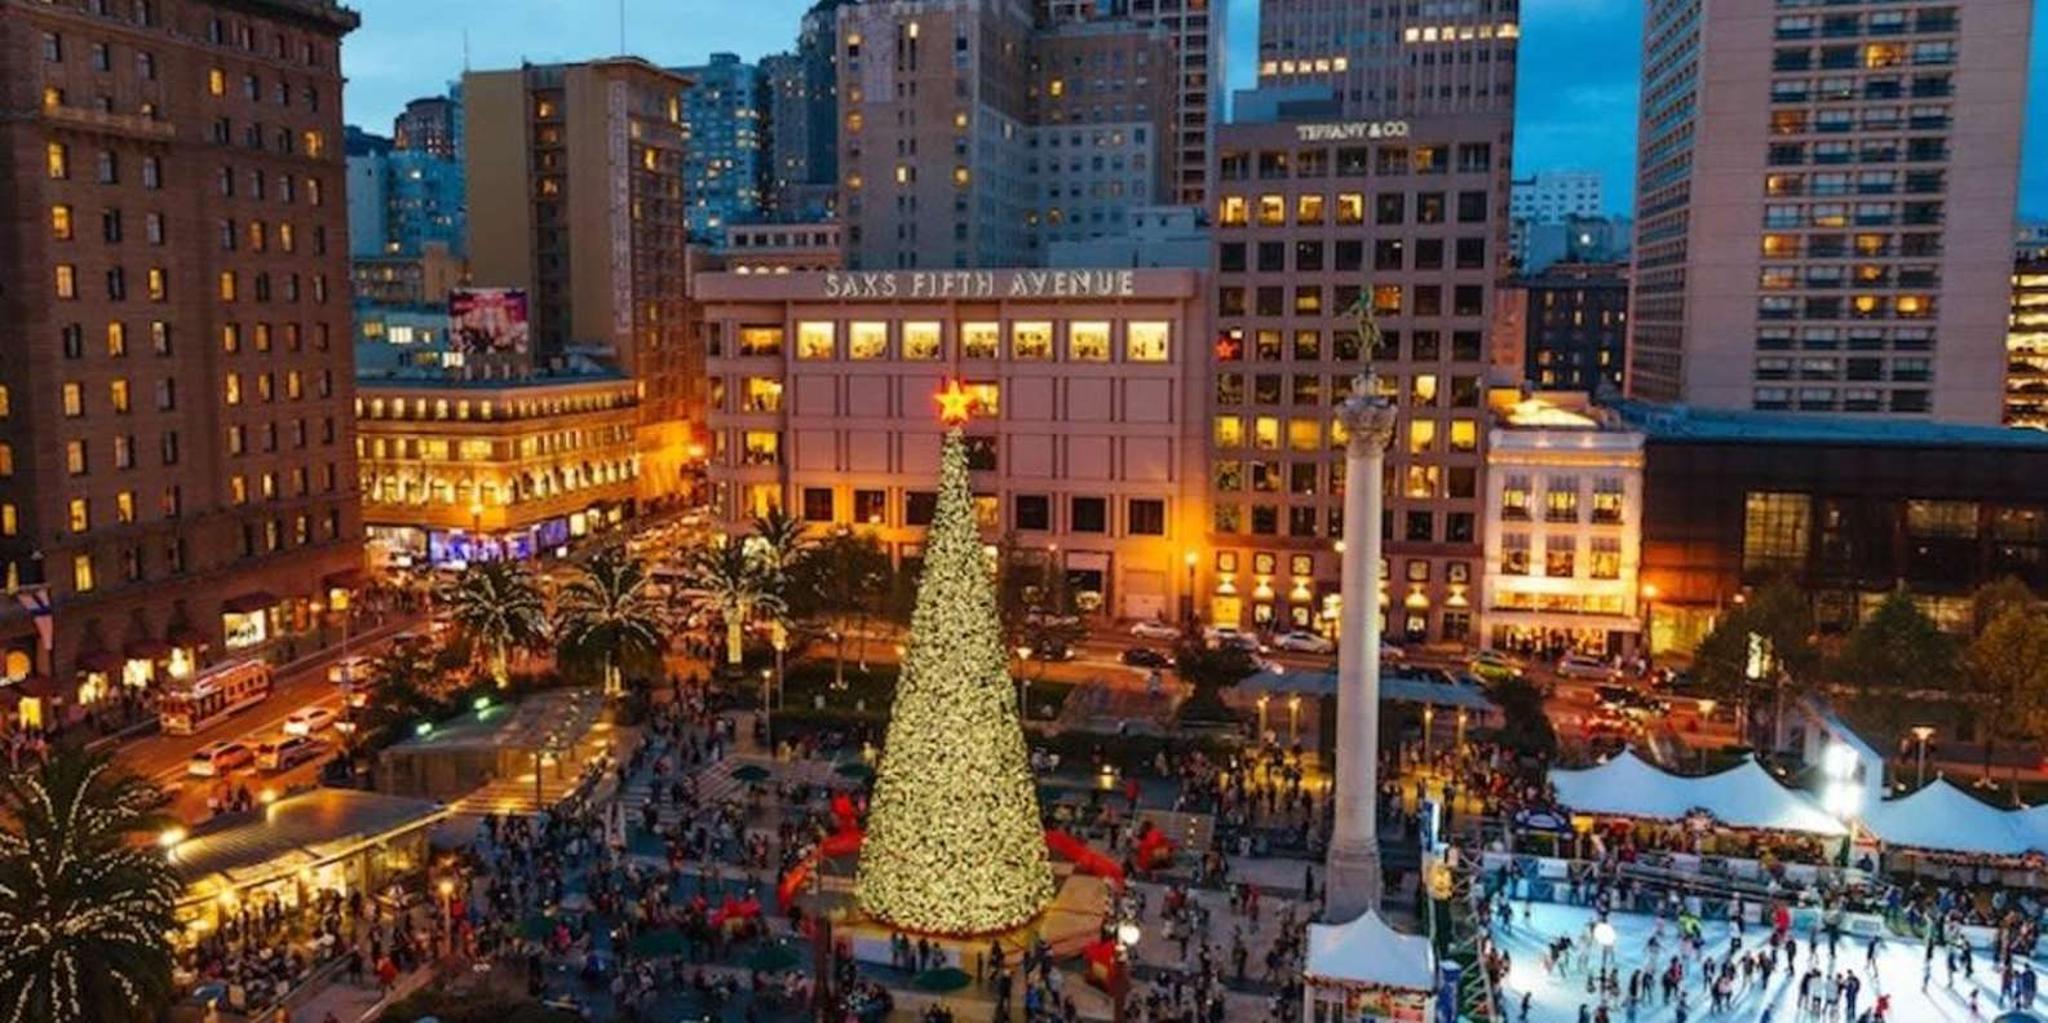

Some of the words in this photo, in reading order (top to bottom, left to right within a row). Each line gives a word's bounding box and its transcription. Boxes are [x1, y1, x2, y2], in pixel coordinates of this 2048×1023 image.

[1368, 122, 1381, 138] &
[911, 272, 994, 297] FIFTH
[1008, 270, 1135, 296] AVENUE
